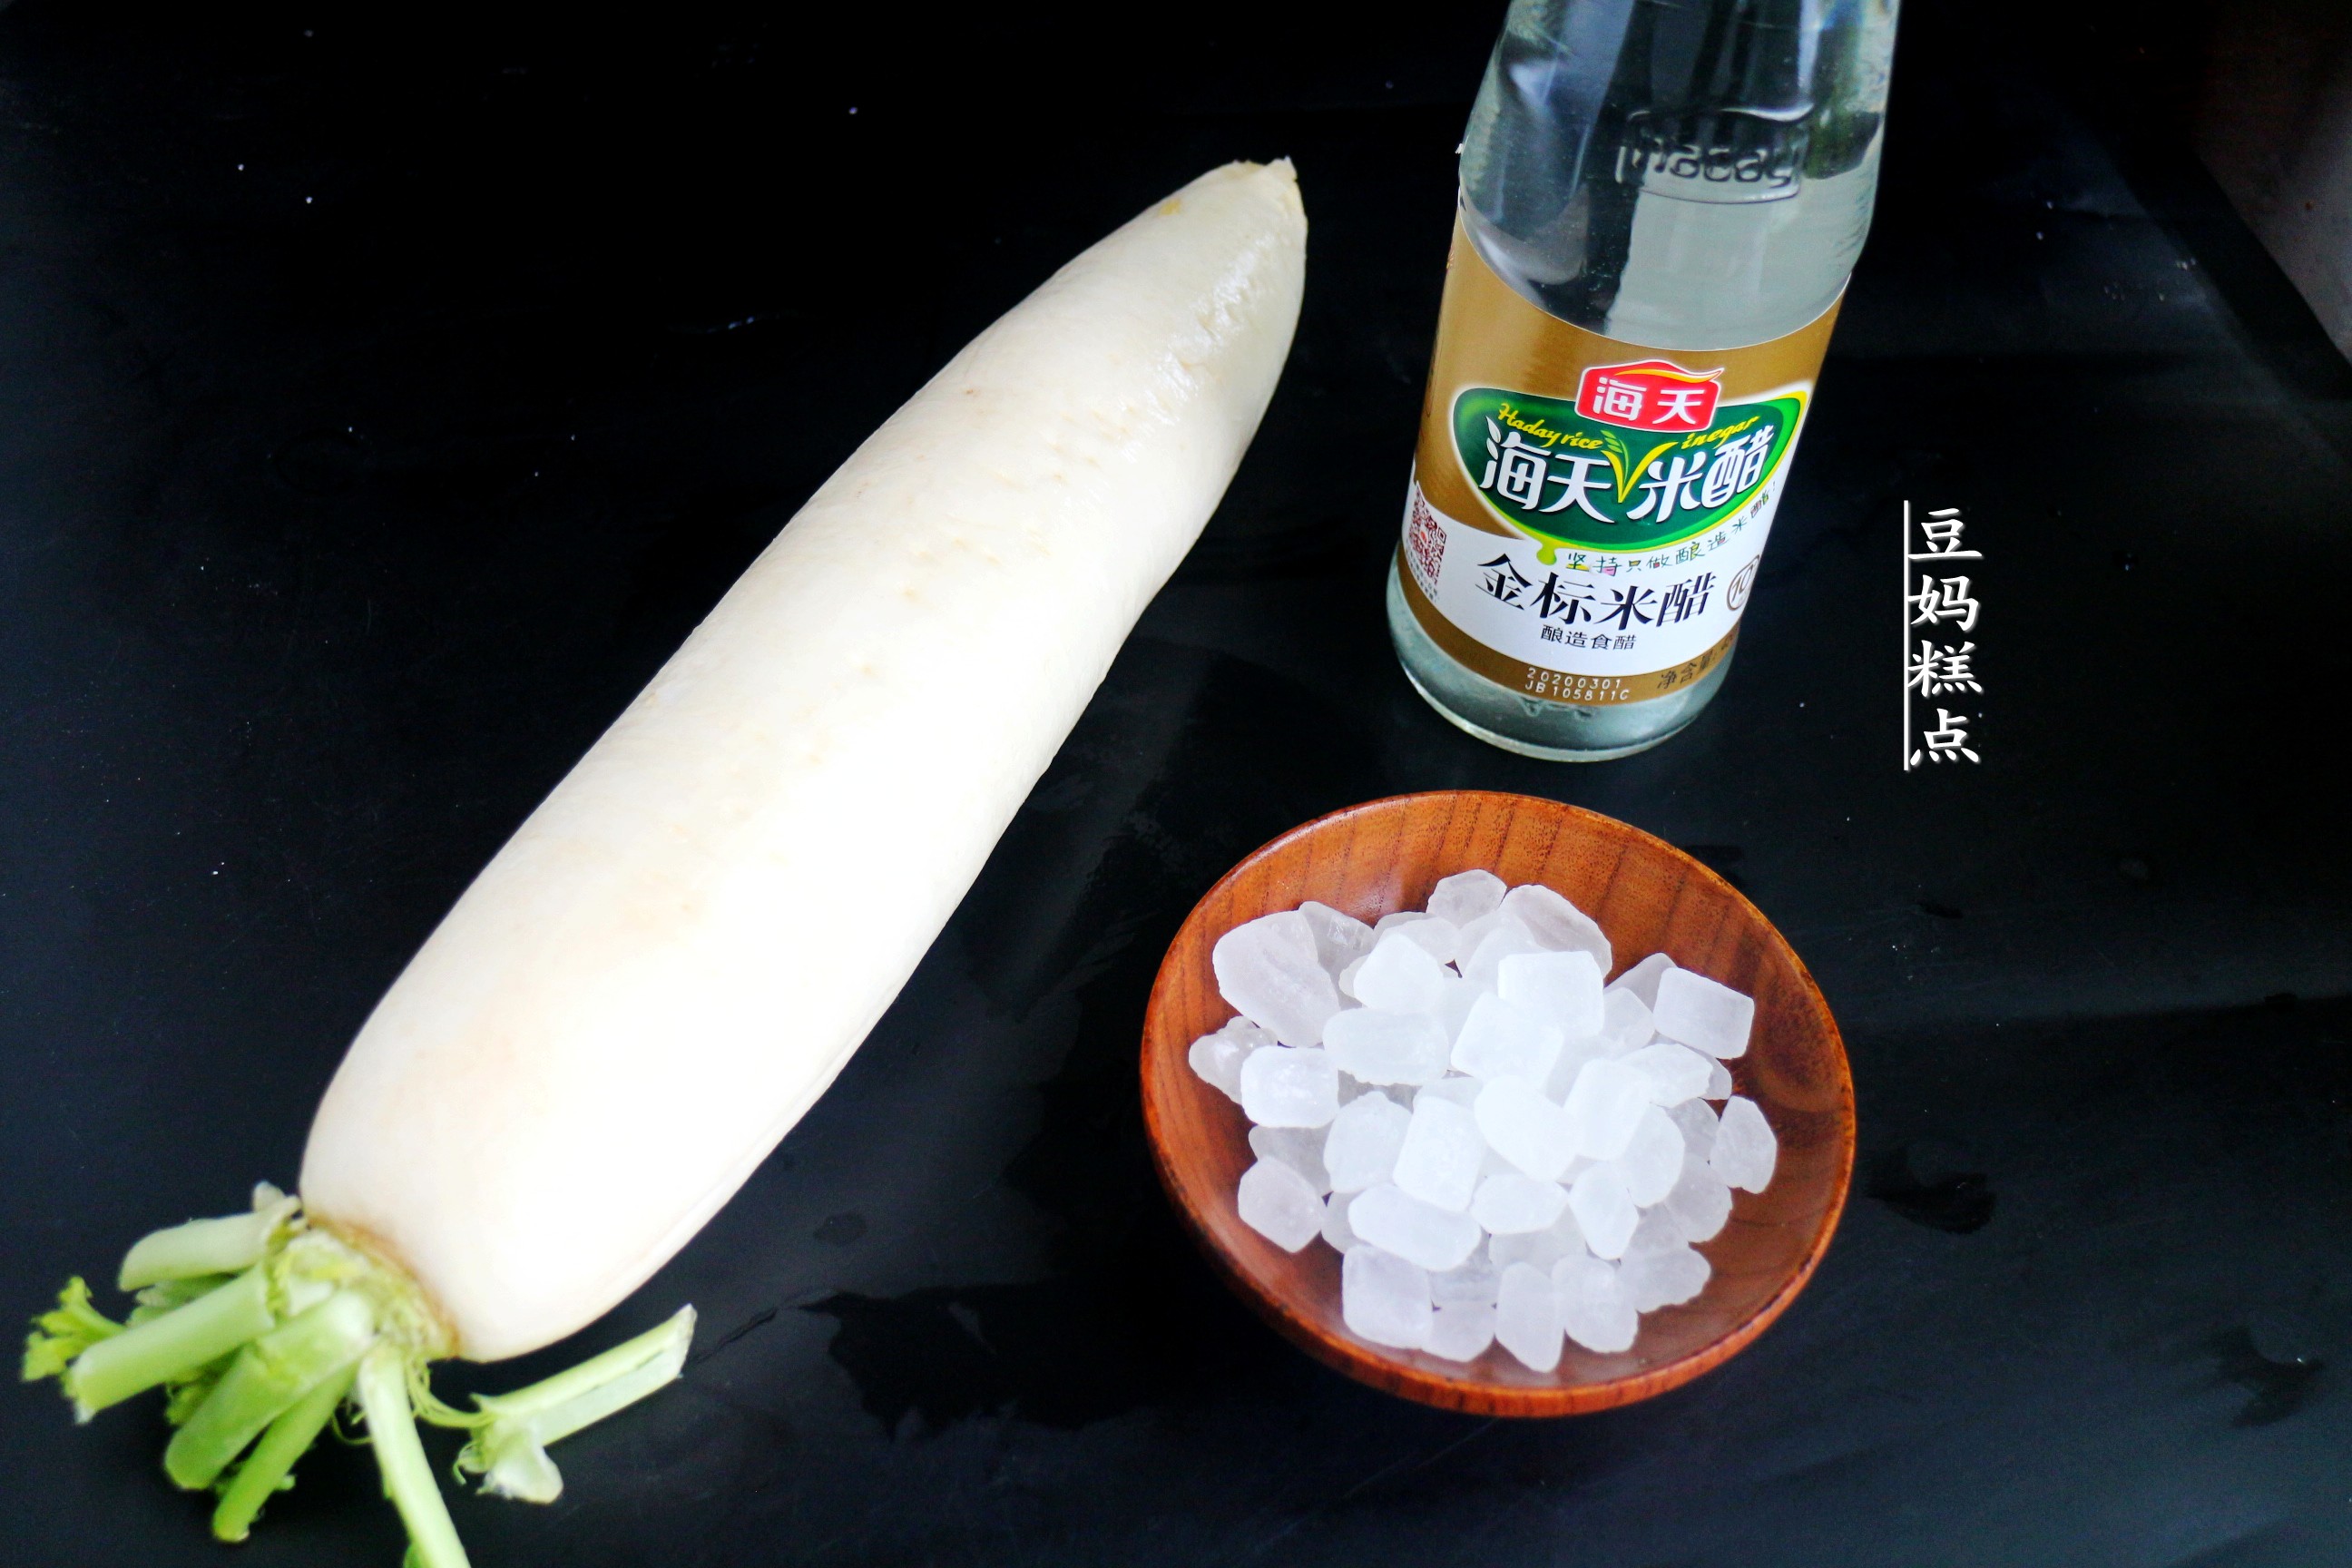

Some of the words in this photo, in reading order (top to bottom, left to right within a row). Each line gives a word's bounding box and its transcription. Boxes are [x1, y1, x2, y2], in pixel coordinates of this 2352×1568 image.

[1593, 377, 1706, 426] 海天
[1498, 403, 1561, 451] Haday
[1561, 431, 1604, 451] rice
[1475, 553, 1717, 629] 金标米醋
[1541, 623, 1637, 652] 酿造食醋
[1526, 667, 1622, 690] 20200301
